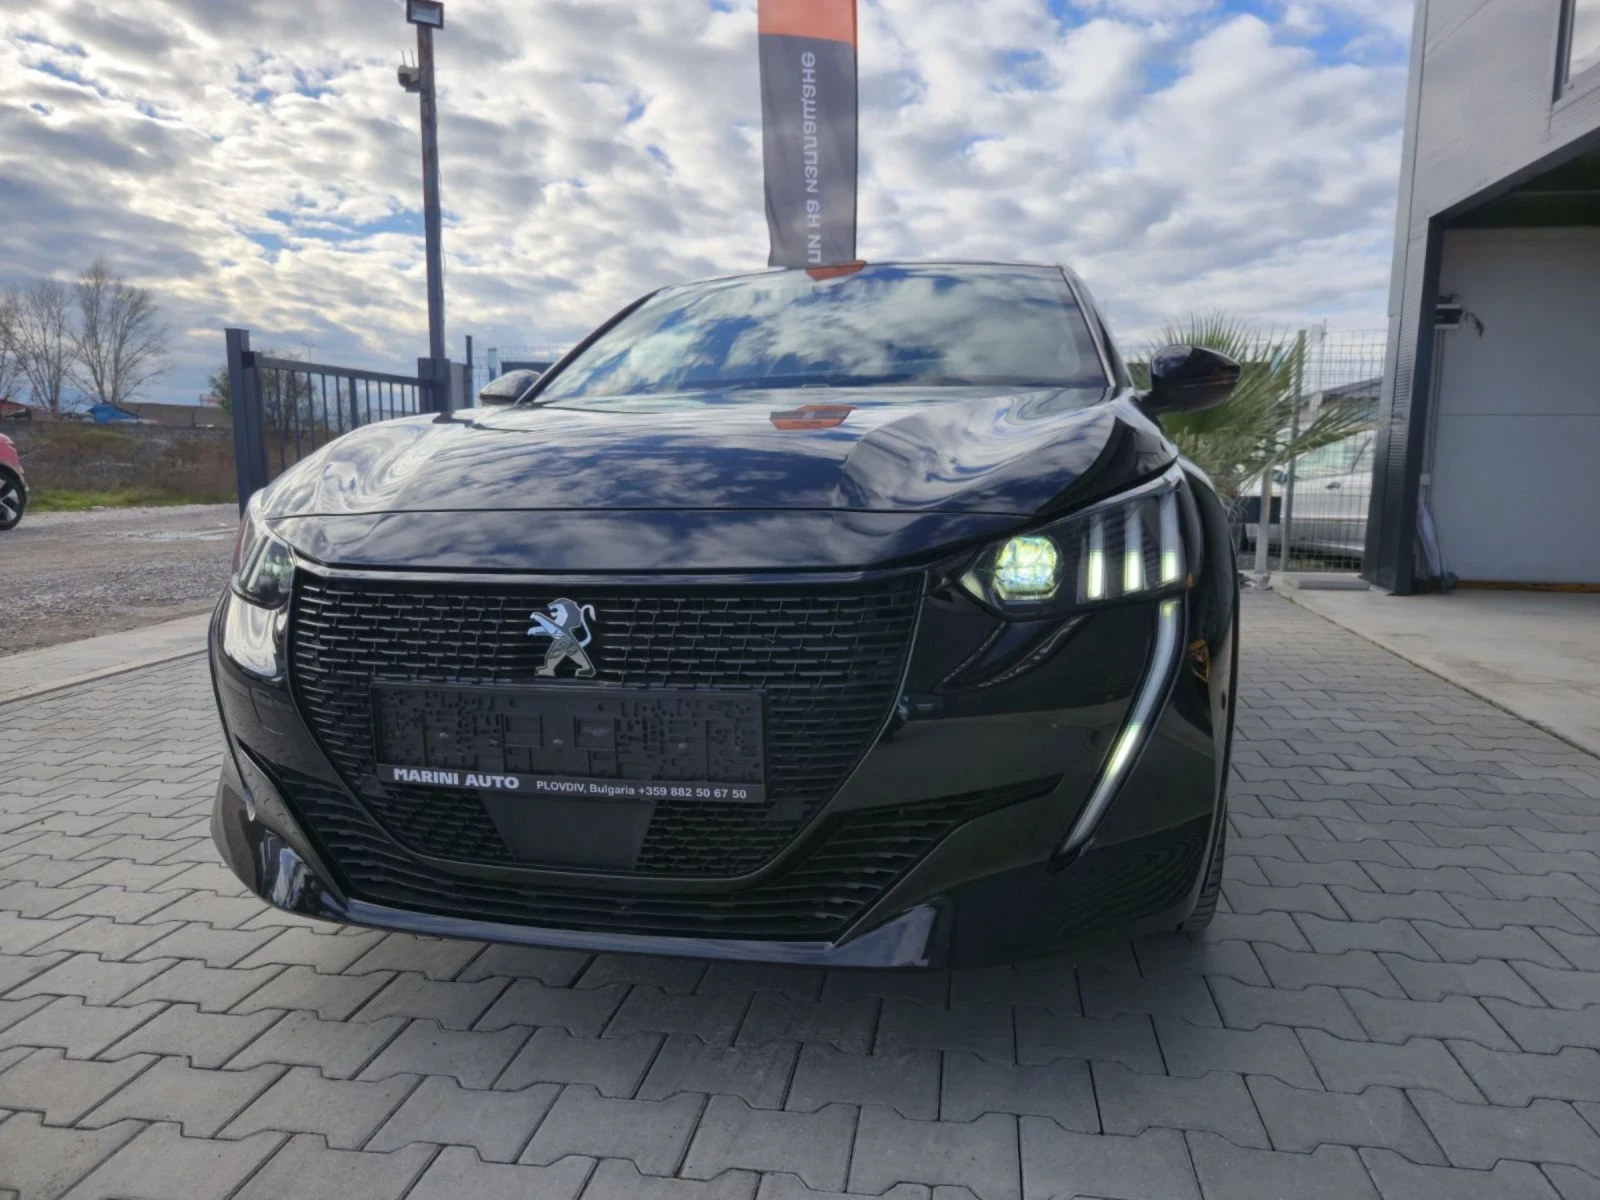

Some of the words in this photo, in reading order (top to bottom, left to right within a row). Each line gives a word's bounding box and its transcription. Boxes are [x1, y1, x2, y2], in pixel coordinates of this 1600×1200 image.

[393, 768, 459, 785] MARINI
[464, 773, 520, 789] AUTO
[536, 780, 587, 794] PLOVDIV,
[590, 783, 635, 796] Bulgaria
[638, 786, 667, 796] +359
[670, 787, 693, 797] 882
[696, 788, 710, 798] 50
[714, 788, 728, 798] 67
[732, 789, 747, 799] 50
